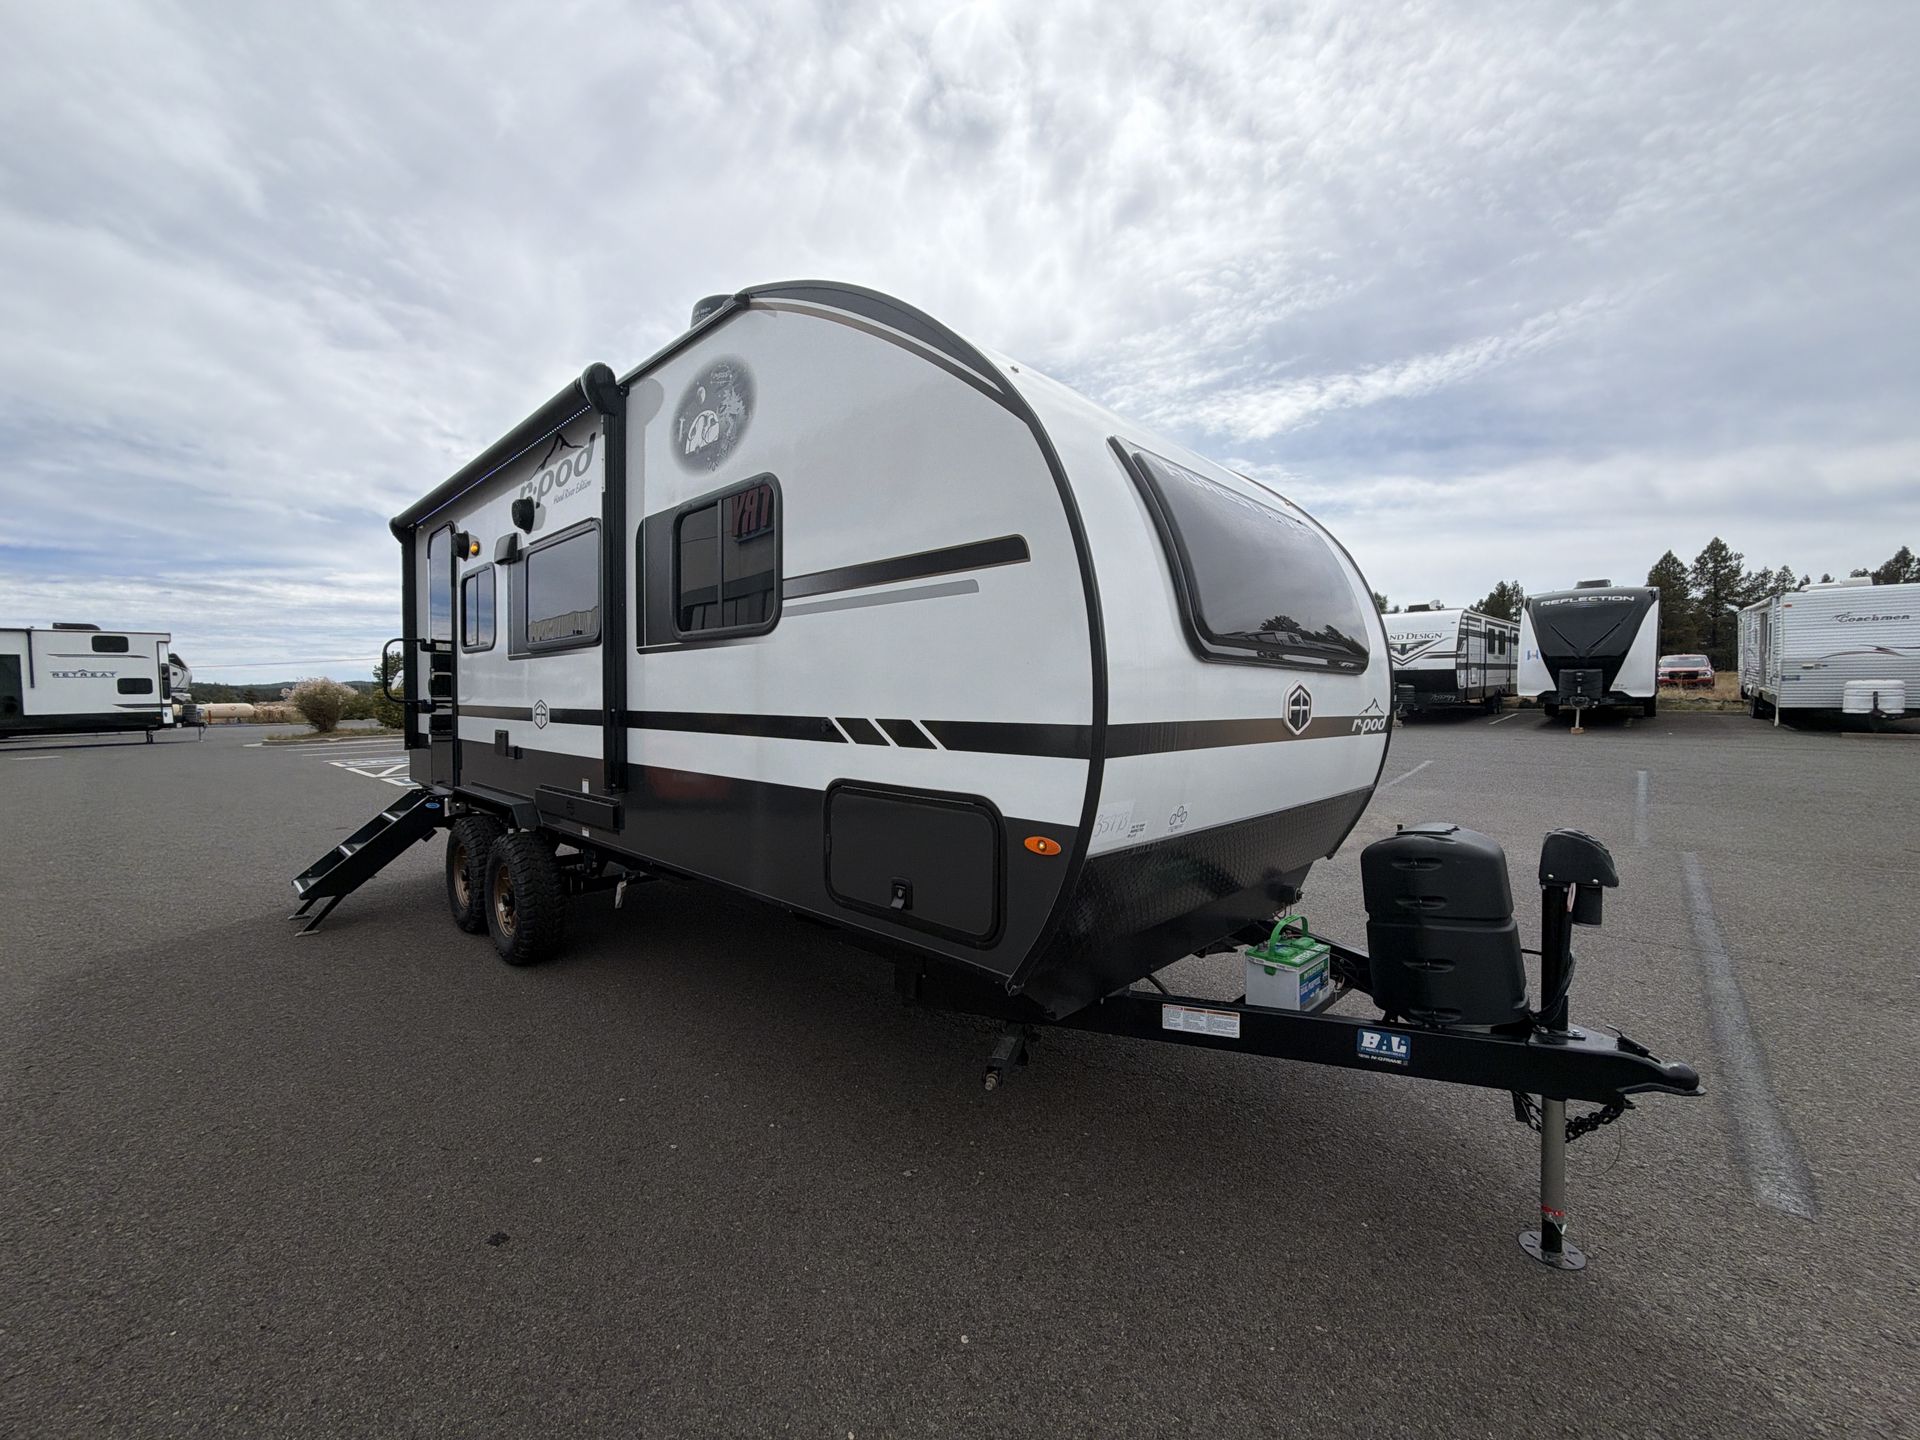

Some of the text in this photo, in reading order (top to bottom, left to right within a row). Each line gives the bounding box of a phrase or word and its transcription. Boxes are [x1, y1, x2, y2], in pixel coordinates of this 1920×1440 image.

[1540, 595, 1635, 607] REFLECTION
[1834, 612, 1911, 624] Coachmen
[1406, 632, 1443, 641] DESIGN
[50, 670, 117, 679] RETREAT
